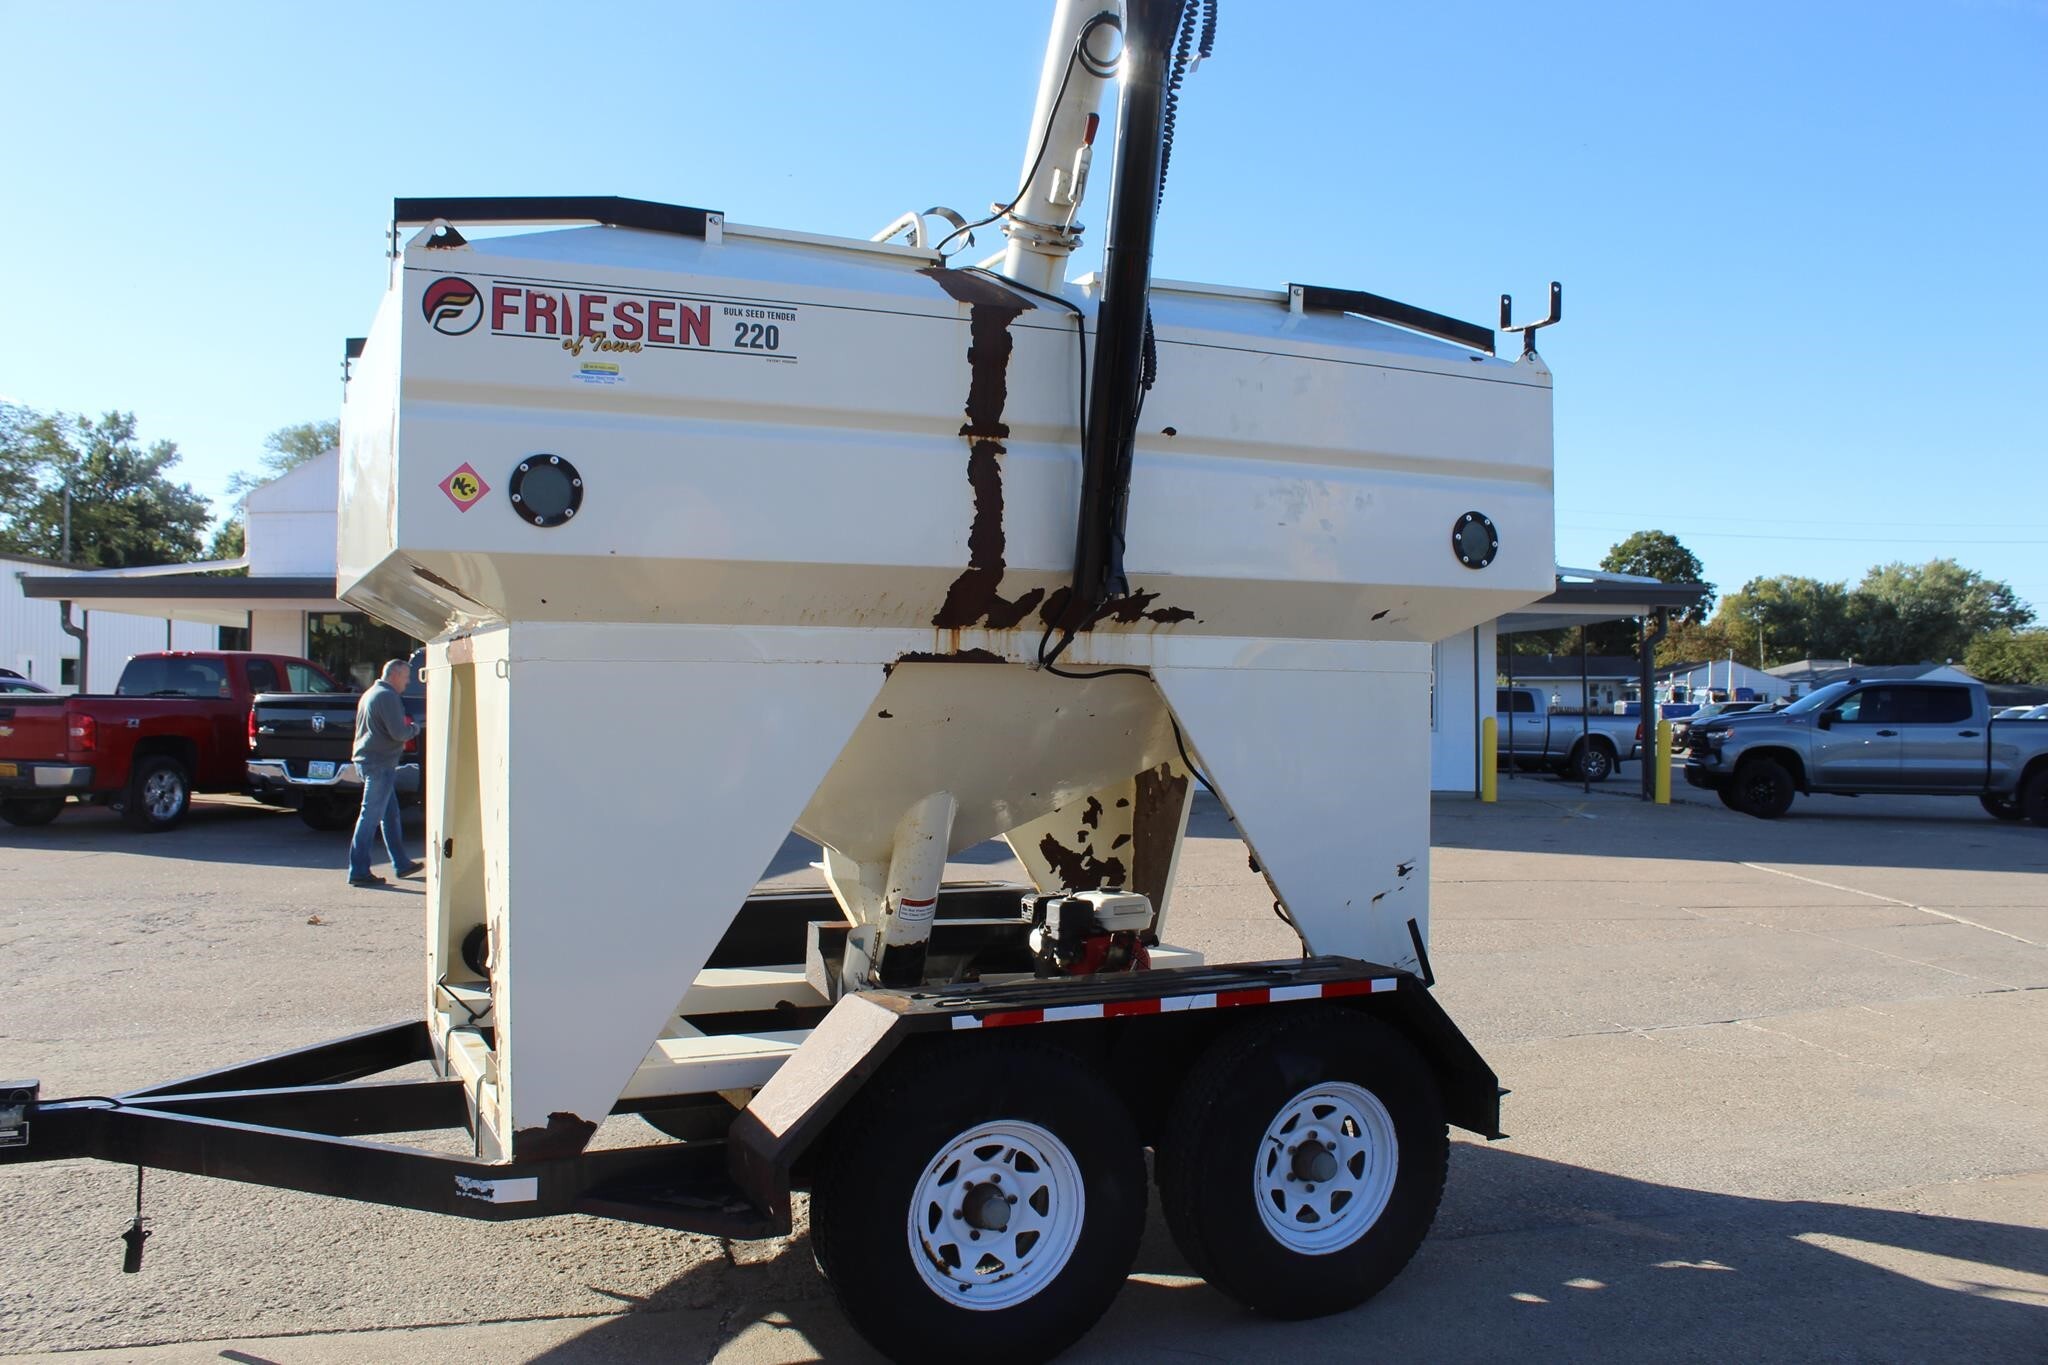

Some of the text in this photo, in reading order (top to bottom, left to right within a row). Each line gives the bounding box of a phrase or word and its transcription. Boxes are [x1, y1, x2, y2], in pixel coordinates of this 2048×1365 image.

[491, 286, 711, 347] FRIESEN
[723, 306, 796, 322] BULK SEED TENDER
[562, 334, 584, 357] of
[734, 321, 780, 351] 220
